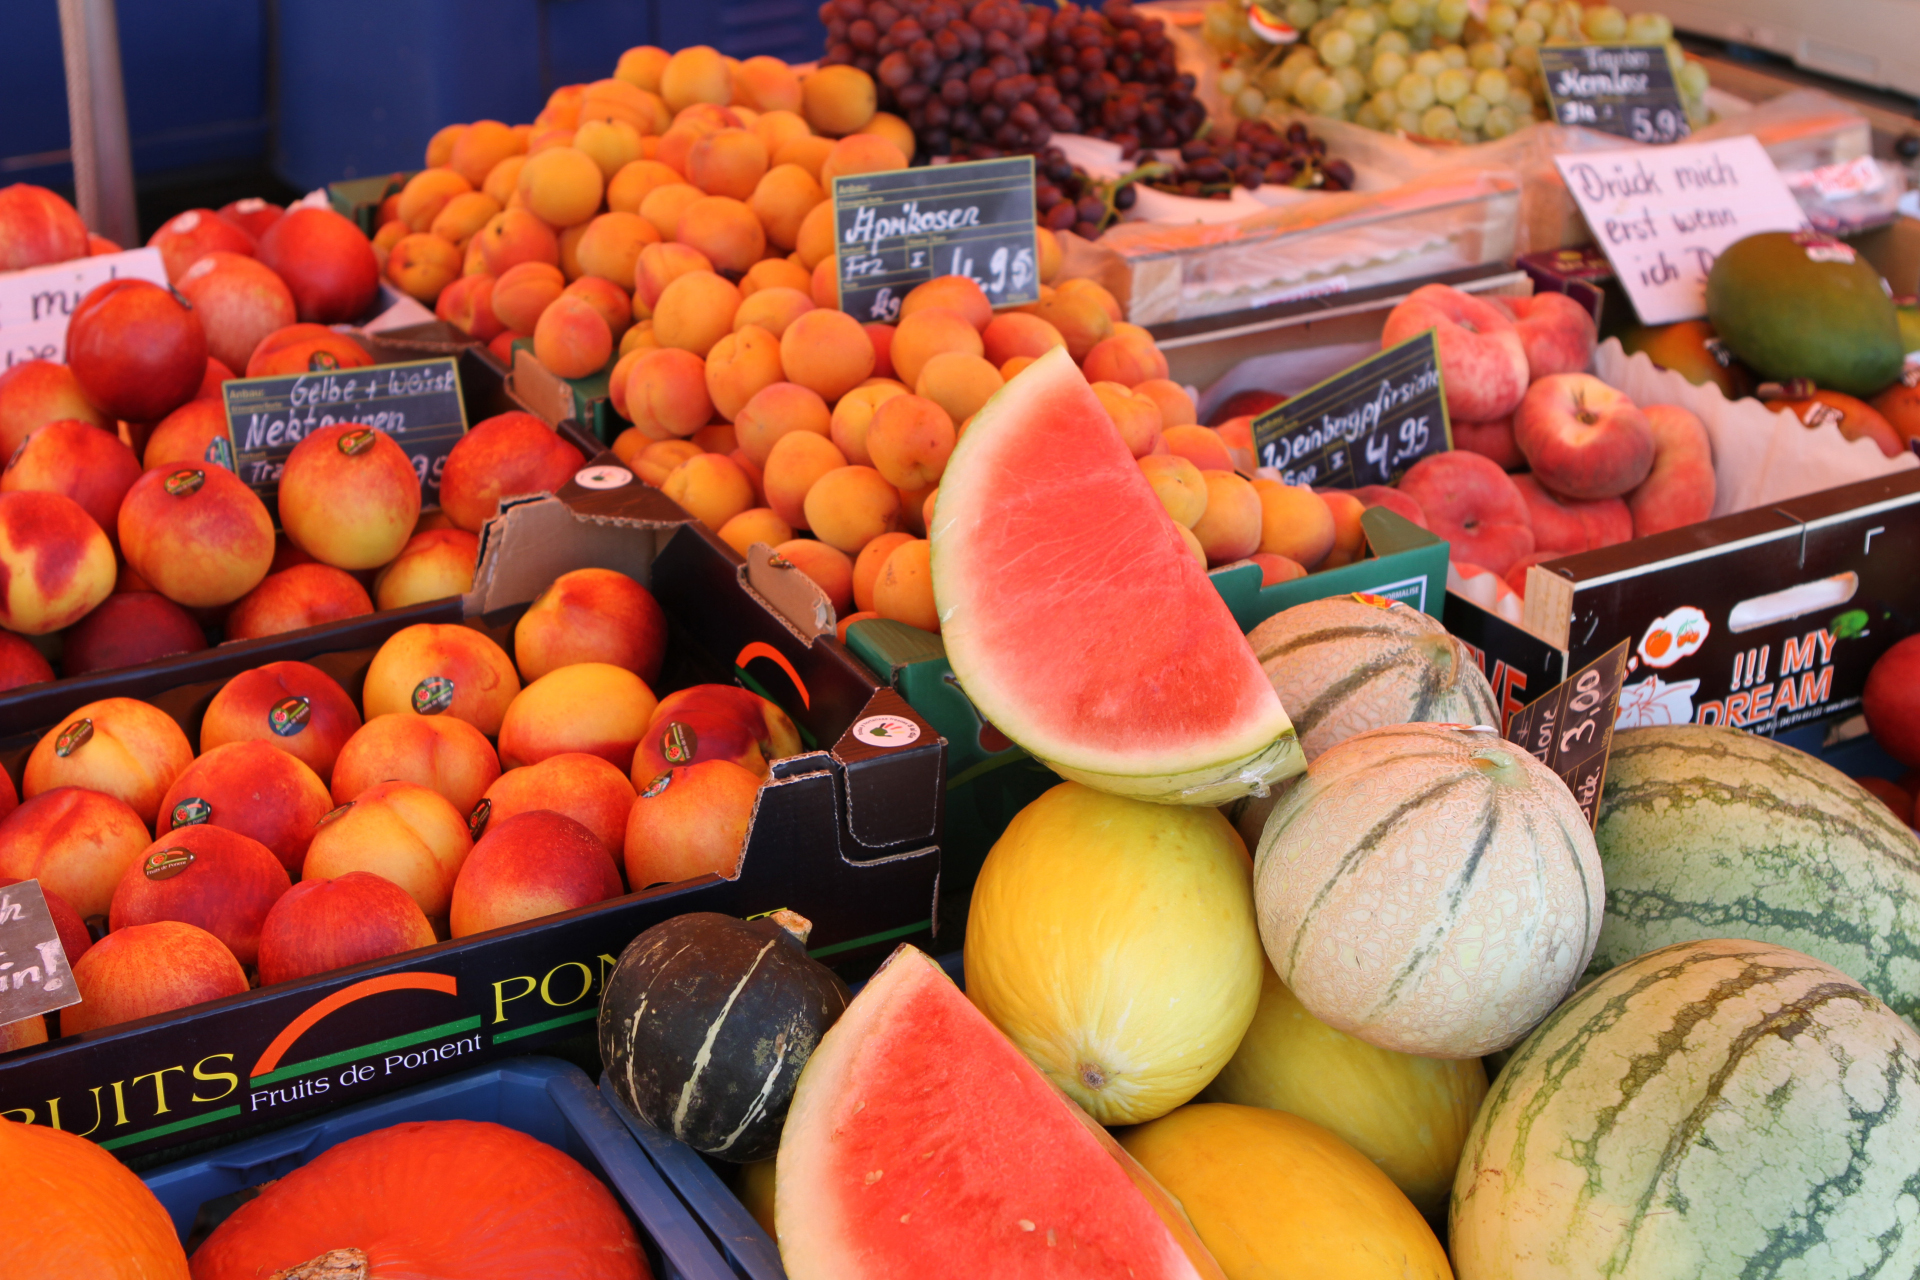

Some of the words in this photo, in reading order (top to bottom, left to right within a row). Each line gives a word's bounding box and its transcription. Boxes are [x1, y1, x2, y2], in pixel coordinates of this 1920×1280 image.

[1571, 161, 1662, 201] Drück
[1674, 153, 1738, 190] mich
[845, 201, 980, 256] Aprikosen
[1605, 207, 1658, 244] erst
[1673, 209, 1737, 234] wenn
[1634, 251, 1679, 287] ich
[290, 375, 357, 407] Gelbe
[1779, 627, 1842, 677] MY
[1696, 665, 1835, 728] DREAM
[146, 866, 160, 876] Fruits
[168, 860, 187, 869] Ponent
[250, 1078, 331, 1112] Fruits
[339, 1064, 376, 1087] de
[384, 1033, 482, 1075] Ponent
